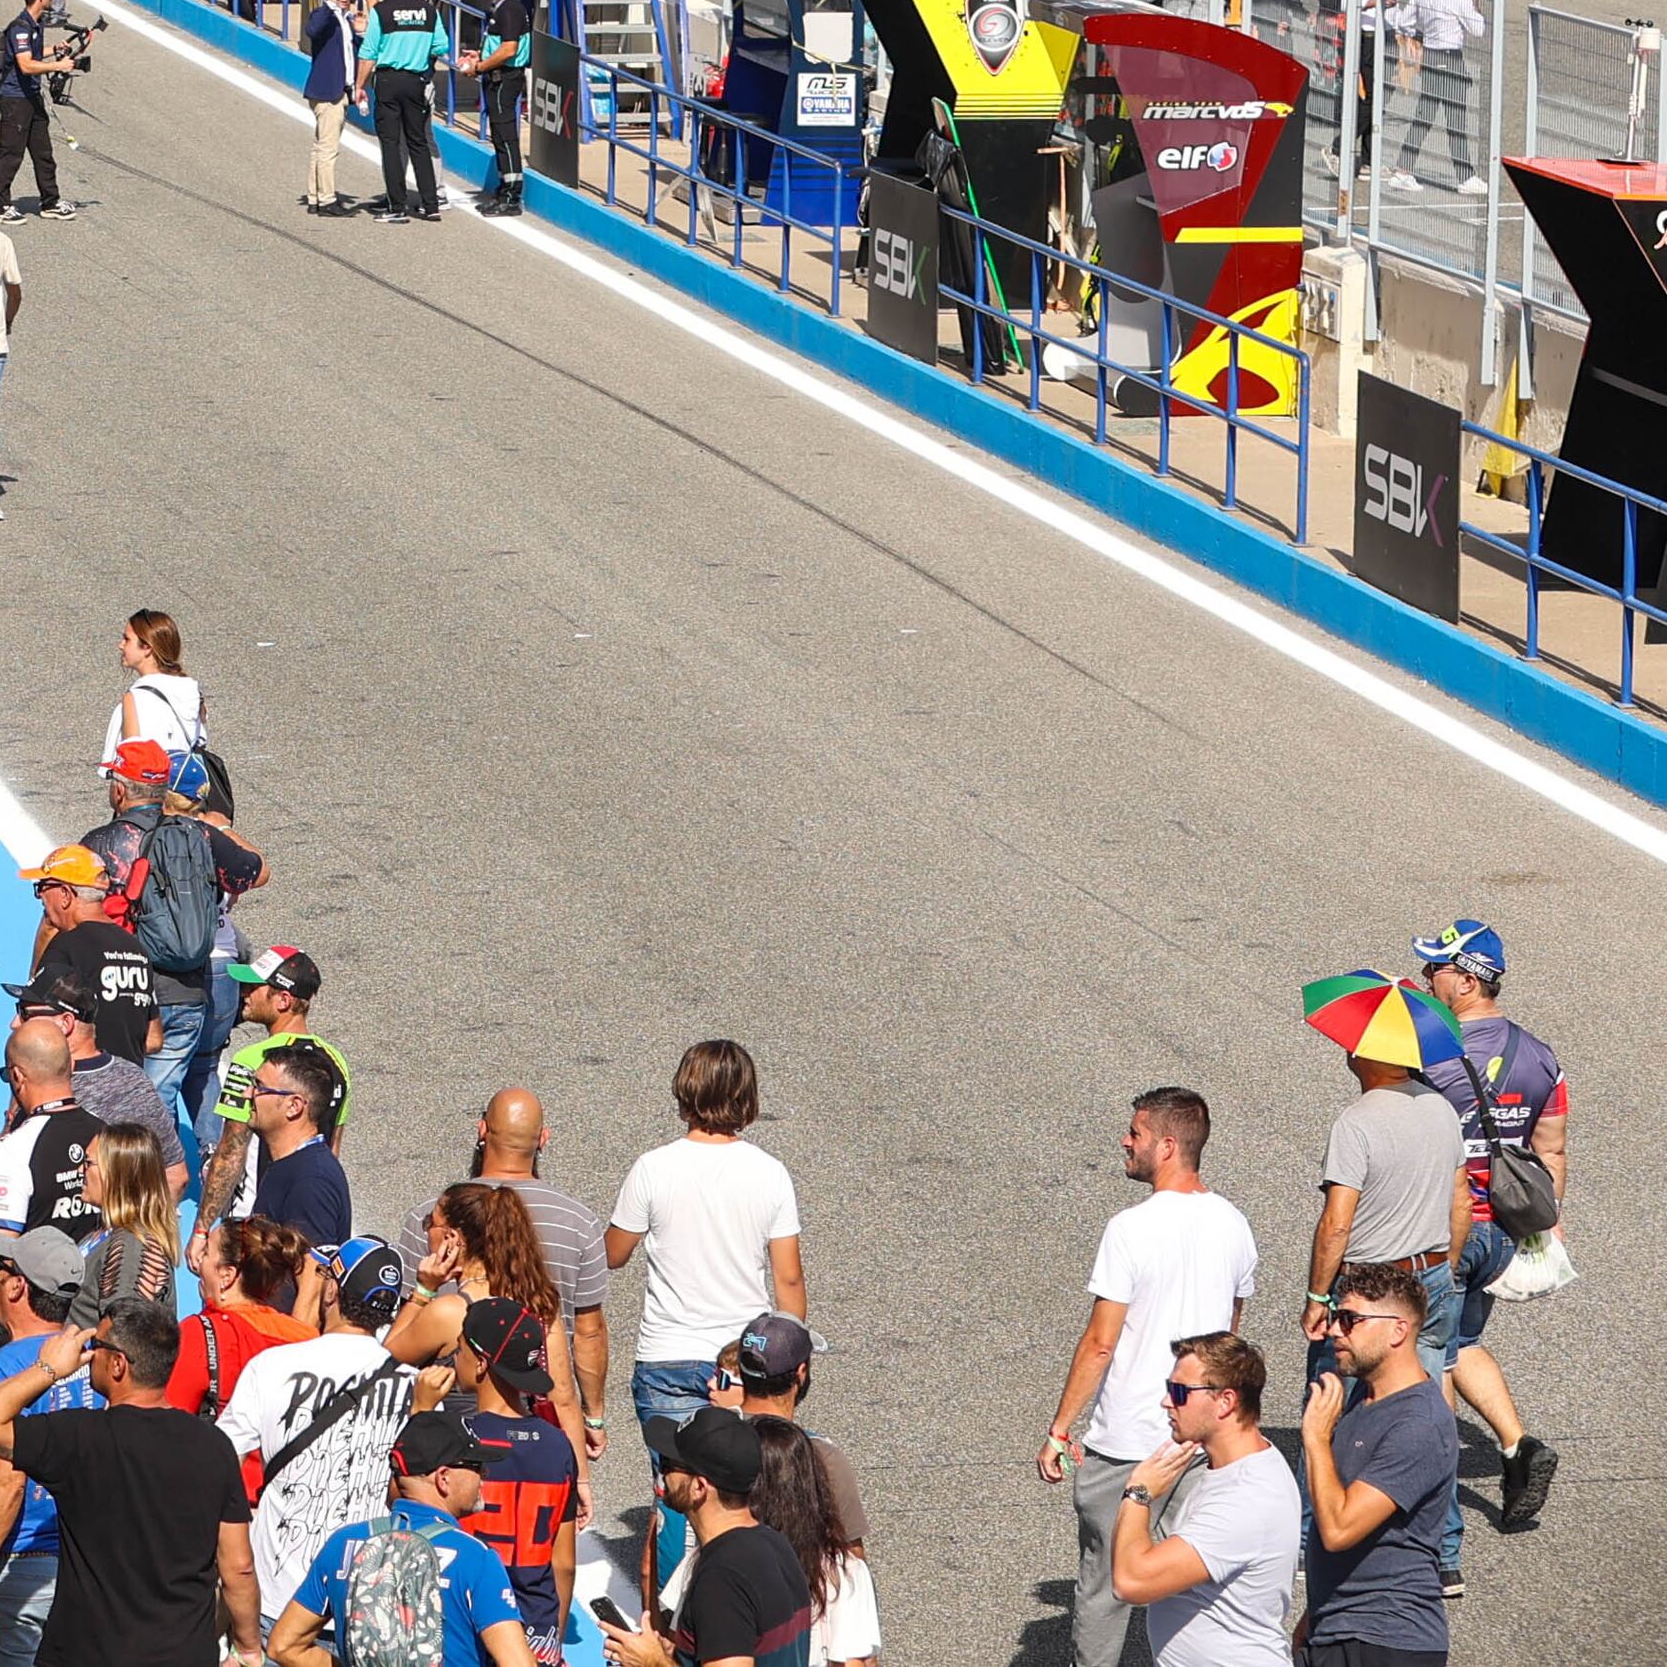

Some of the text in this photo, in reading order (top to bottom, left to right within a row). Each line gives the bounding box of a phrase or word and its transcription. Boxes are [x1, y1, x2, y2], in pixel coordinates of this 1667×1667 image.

[393, 8, 427, 22] servi
[533, 78, 574, 140] SBK
[1157, 146, 1208, 170] elf
[874, 227, 930, 306] SBK
[1363, 442, 1446, 549] SBK
[100, 966, 149, 1001] guru
[208, 1333, 218, 1371] UNDER
